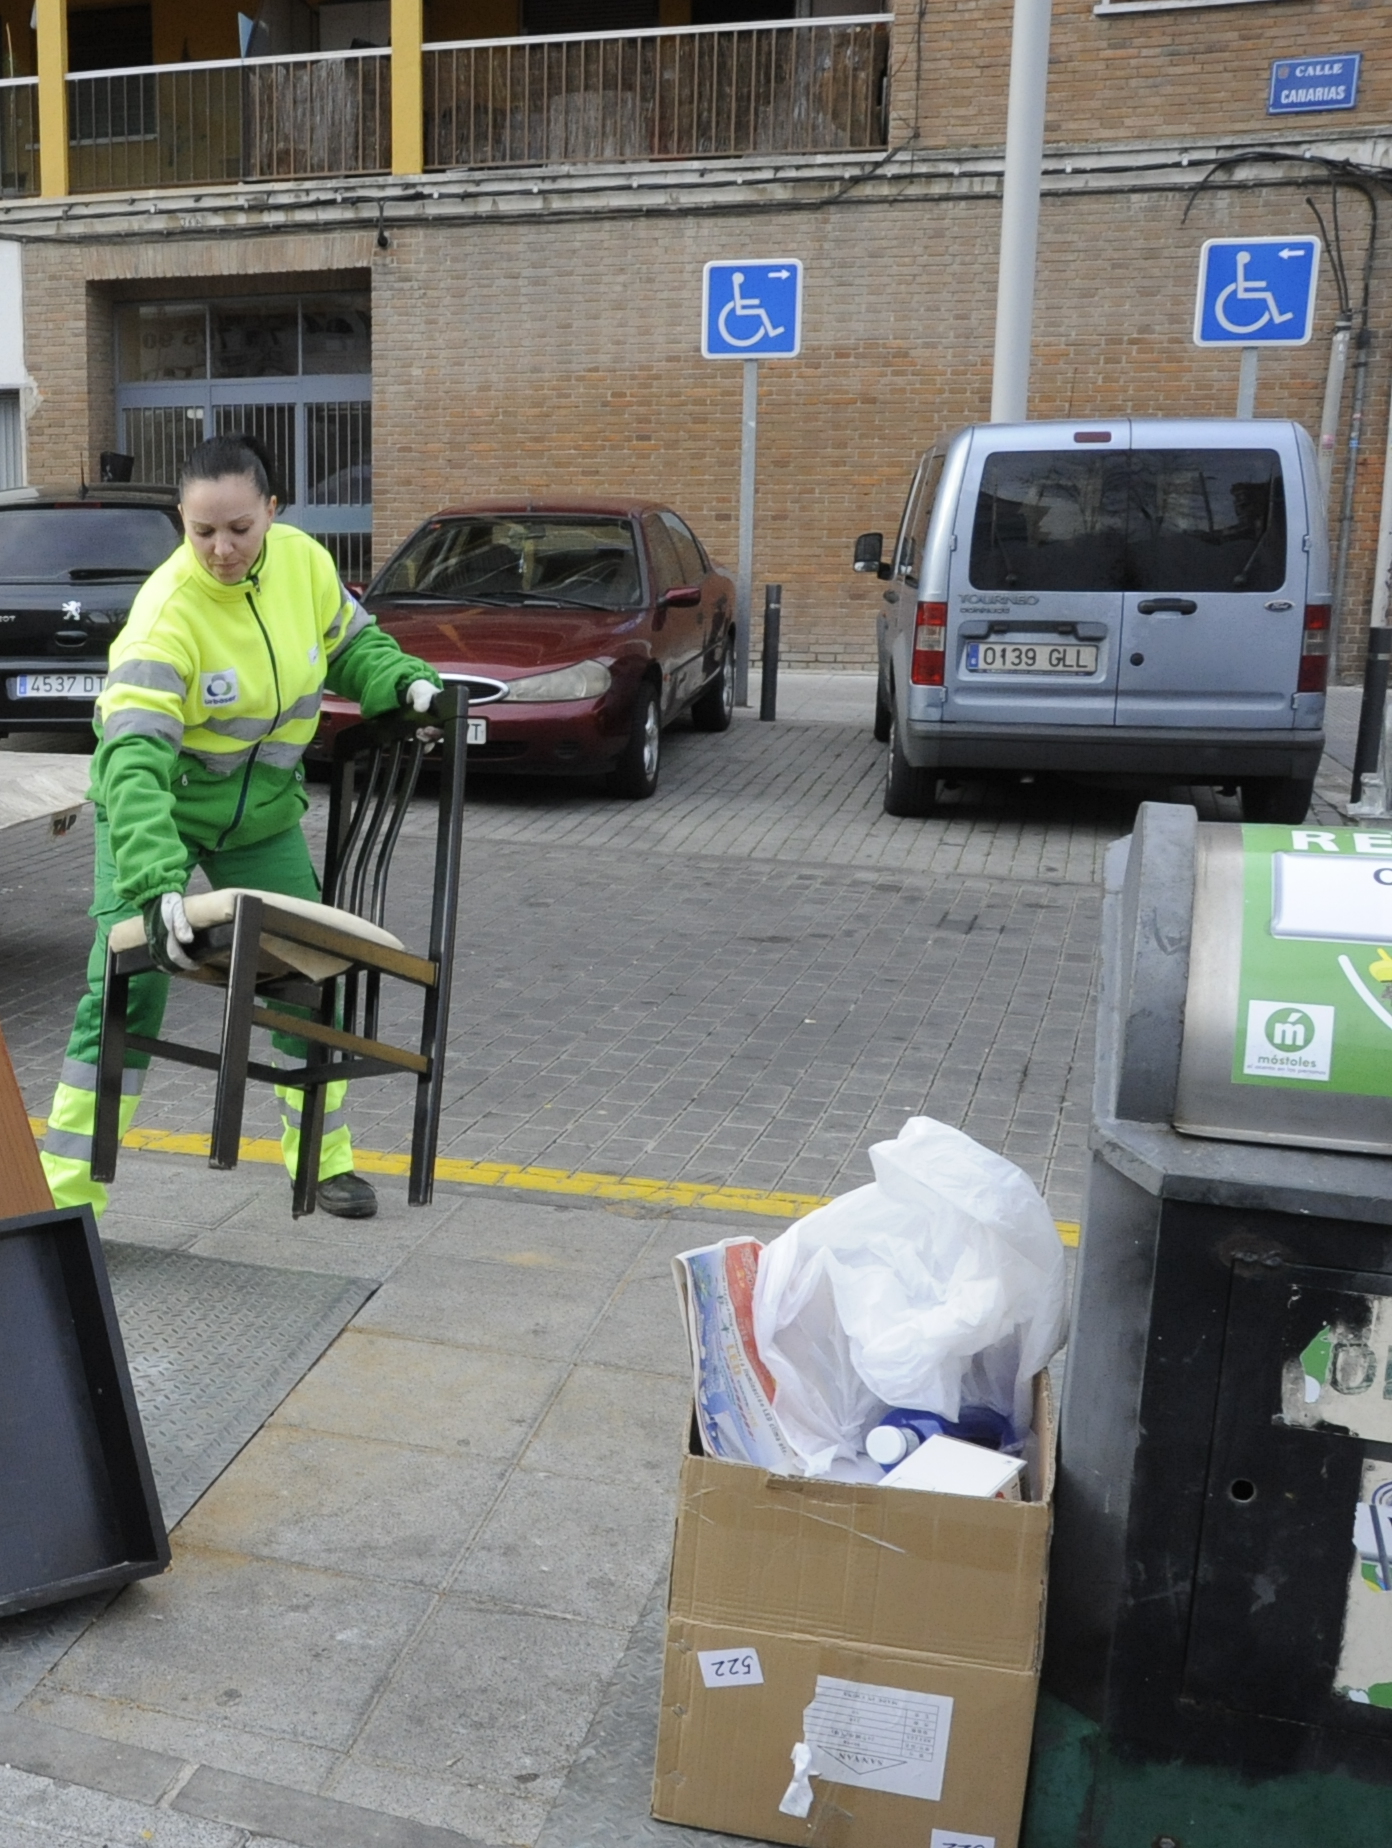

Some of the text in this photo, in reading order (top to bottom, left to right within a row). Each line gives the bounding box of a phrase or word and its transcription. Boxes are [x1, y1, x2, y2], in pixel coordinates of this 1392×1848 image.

[1295, 62, 1343, 77] CALLE
[1280, 85, 1346, 104] CANARIAS
[958, 594, 1040, 606] TOURNEO
[983, 646, 1088, 669] 0139 GLL
[31, 675, 107, 693] 4537 DT
[204, 694, 237, 705] urbaser
[1257, 1054, 1317, 1068] móstoles
[710, 1655, 754, 1678] 522
